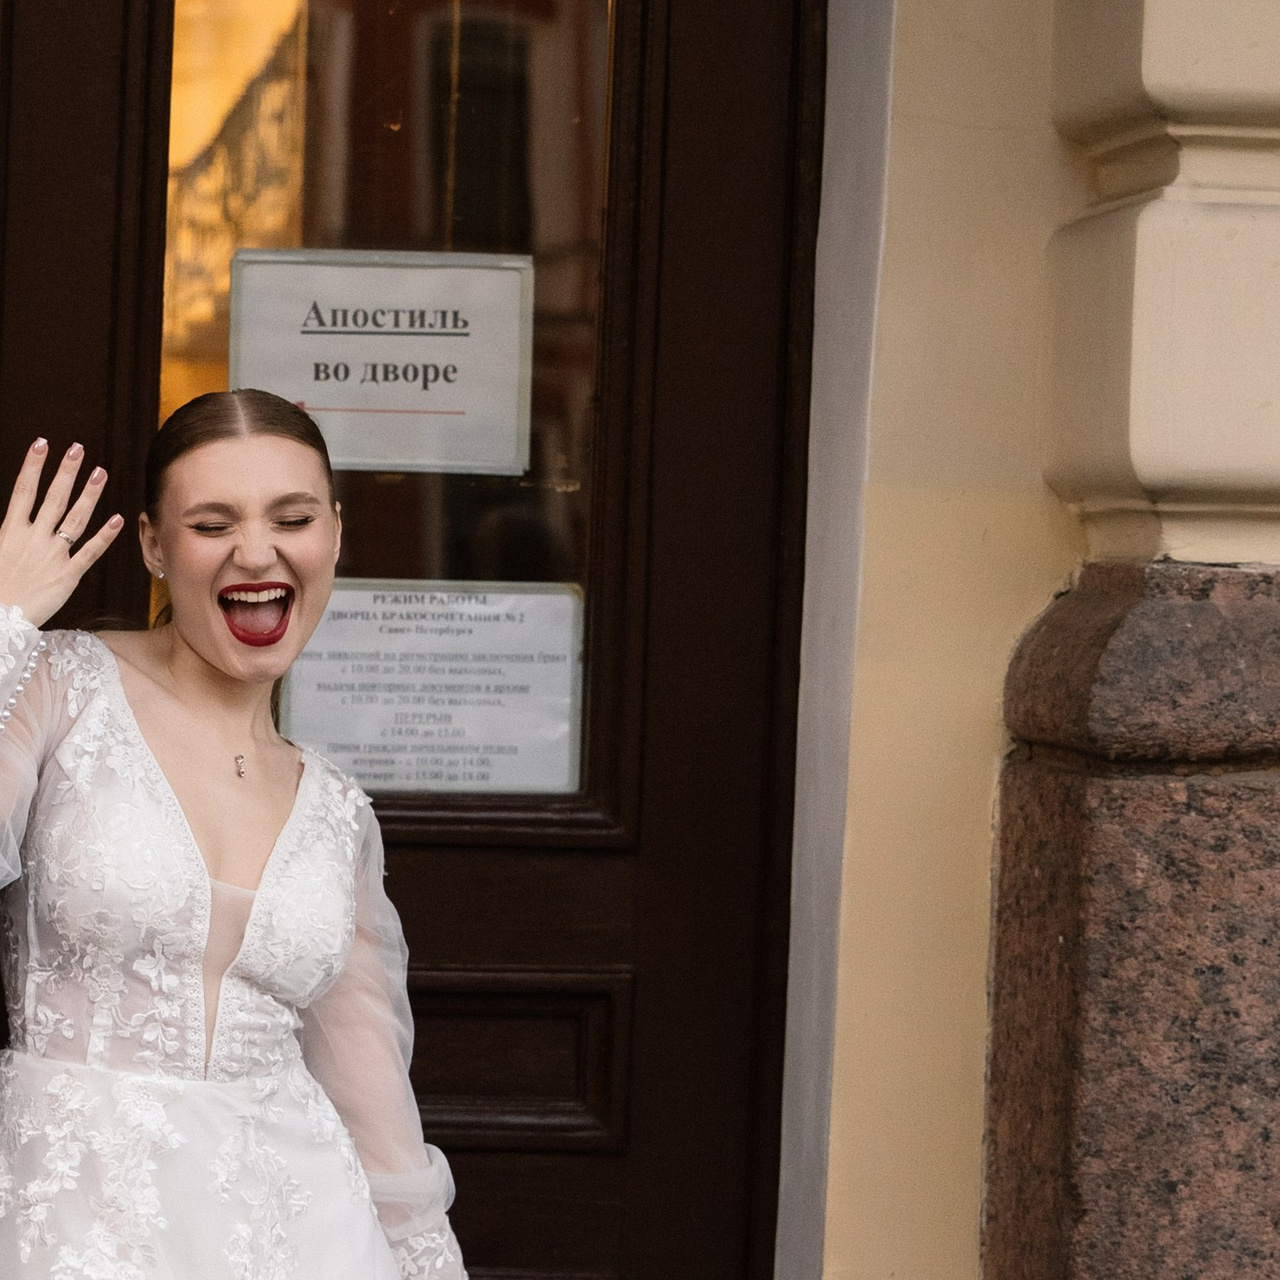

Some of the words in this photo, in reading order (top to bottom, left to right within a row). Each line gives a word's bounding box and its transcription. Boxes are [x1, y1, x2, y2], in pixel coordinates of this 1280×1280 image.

[302, 300, 469, 331] Апостиль
[313, 362, 349, 382] во
[360, 362, 458, 391] дворе
[373, 594, 427, 605] РЕЖИМ
[429, 595, 487, 606] РАБОТЫ
[327, 611, 378, 622] ДВОРЦА
